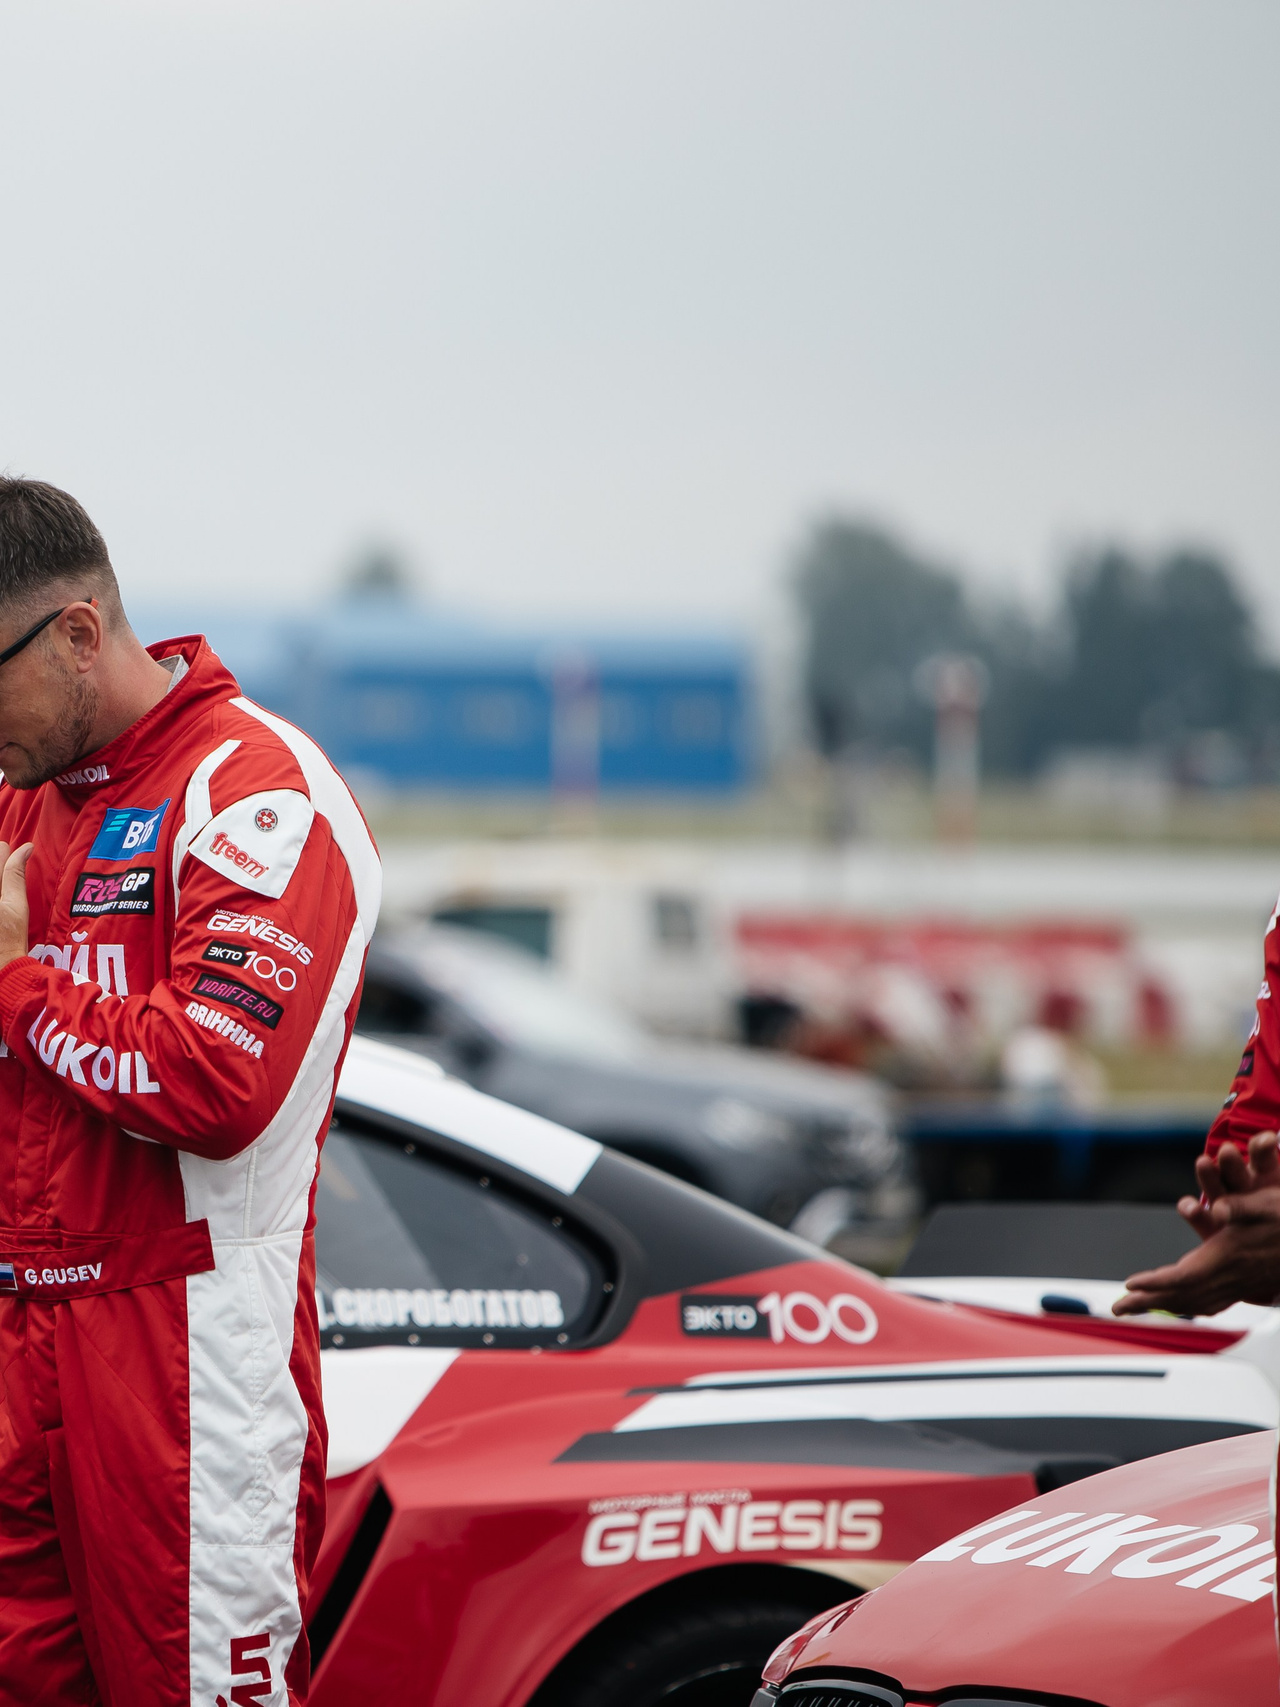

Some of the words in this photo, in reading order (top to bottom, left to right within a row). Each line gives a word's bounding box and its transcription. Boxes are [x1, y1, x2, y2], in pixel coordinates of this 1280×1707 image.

[55, 765, 110, 786] LUKOIL
[122, 813, 160, 849] ВТБ
[209, 832, 266, 880] freem
[121, 873, 151, 892] GP
[118, 900, 149, 910] SERIES
[206, 914, 314, 966] GENESIS
[208, 946, 243, 961] ЭКТО
[244, 950, 297, 992] 100
[197, 978, 278, 1019] VDRIFTE.RU
[26, 1006, 161, 1094] LUKOIL
[24, 1262, 102, 1285] G.GUSEV
[683, 1305, 758, 1331] ЭКТО
[757, 1291, 879, 1344] 100
[581, 1500, 884, 1567] GENESIS
